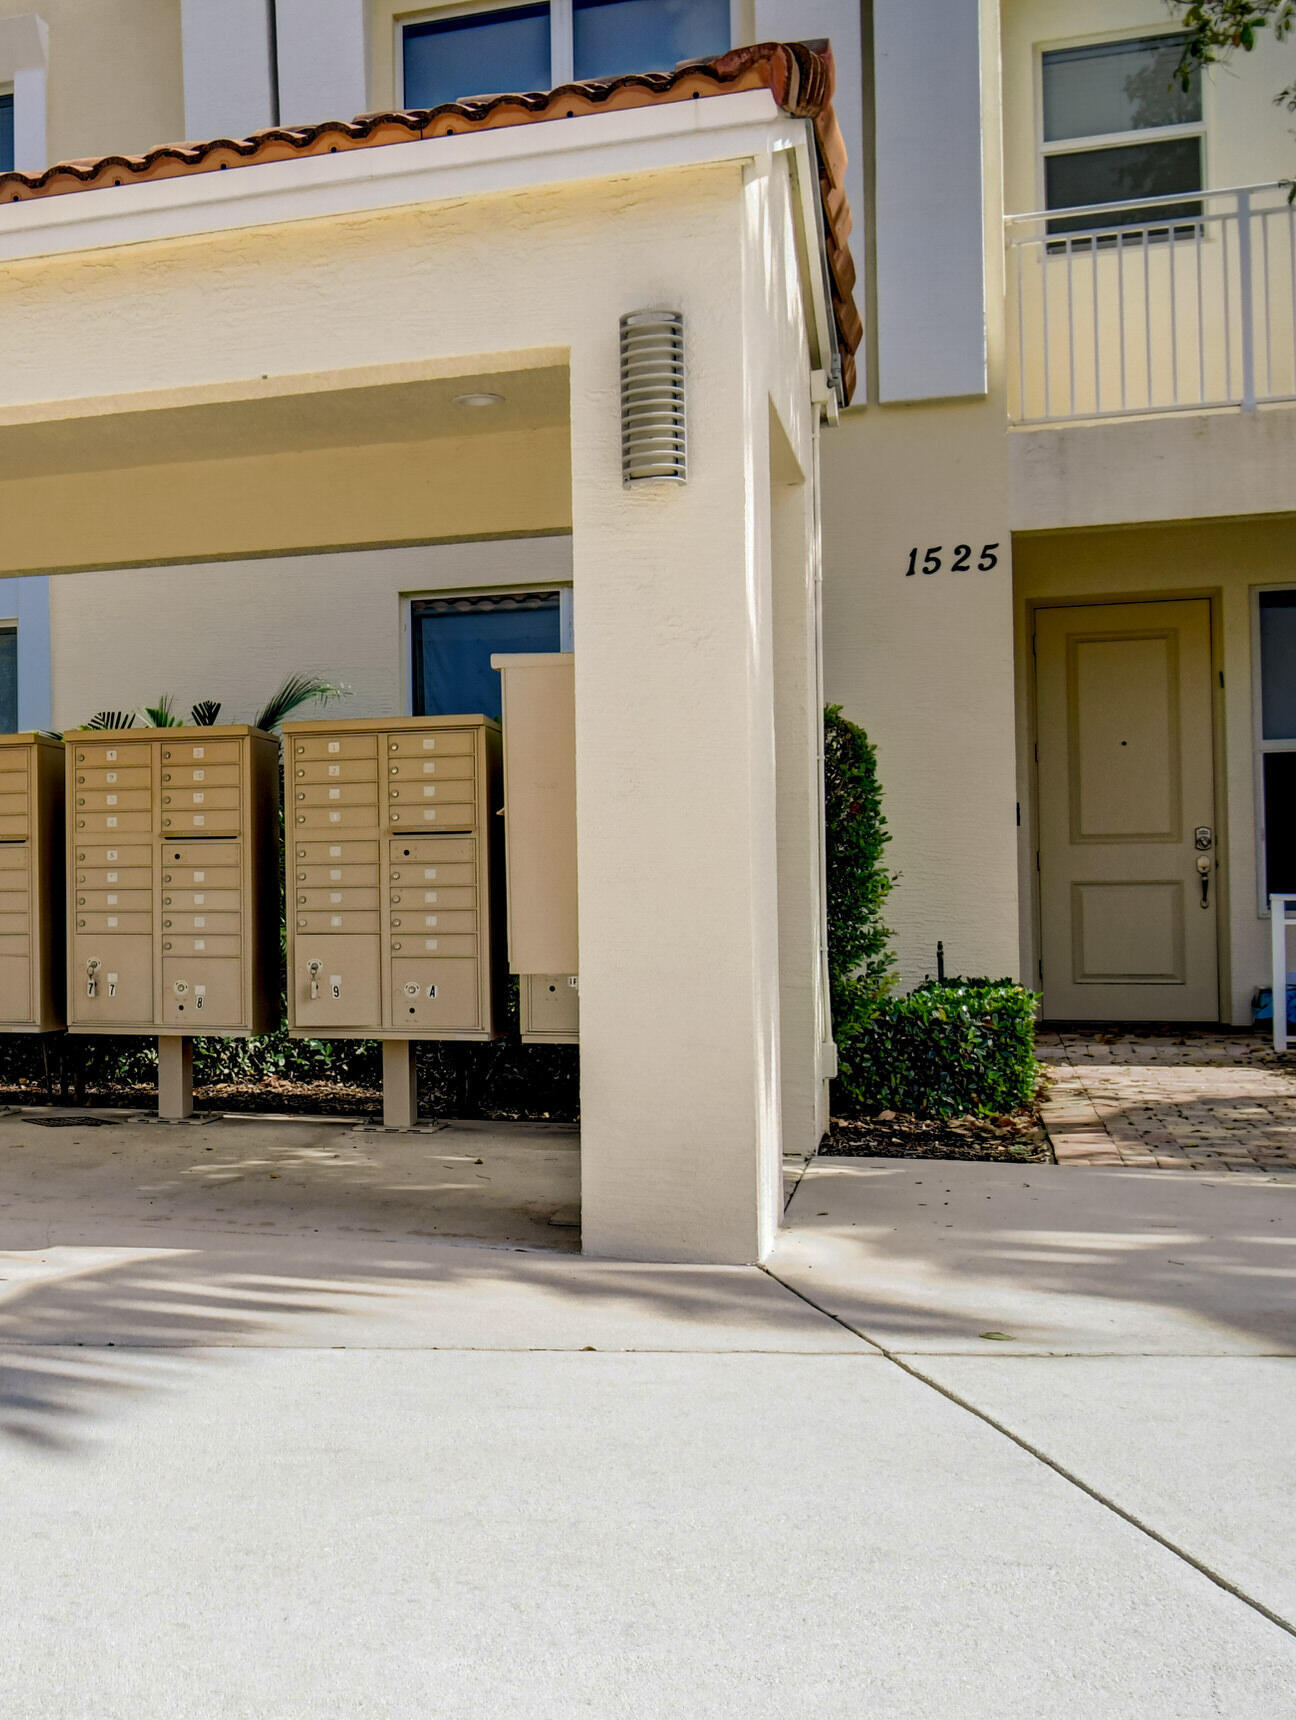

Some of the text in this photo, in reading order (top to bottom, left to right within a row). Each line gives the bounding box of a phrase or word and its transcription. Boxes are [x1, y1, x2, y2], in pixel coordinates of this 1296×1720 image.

[905, 542, 1000, 577] 1525
[88, 982, 94, 994] 7
[109, 983, 115, 996] 7
[333, 985, 340, 998] 9
[429, 984, 436, 998] A
[197, 996, 203, 1009] 8
